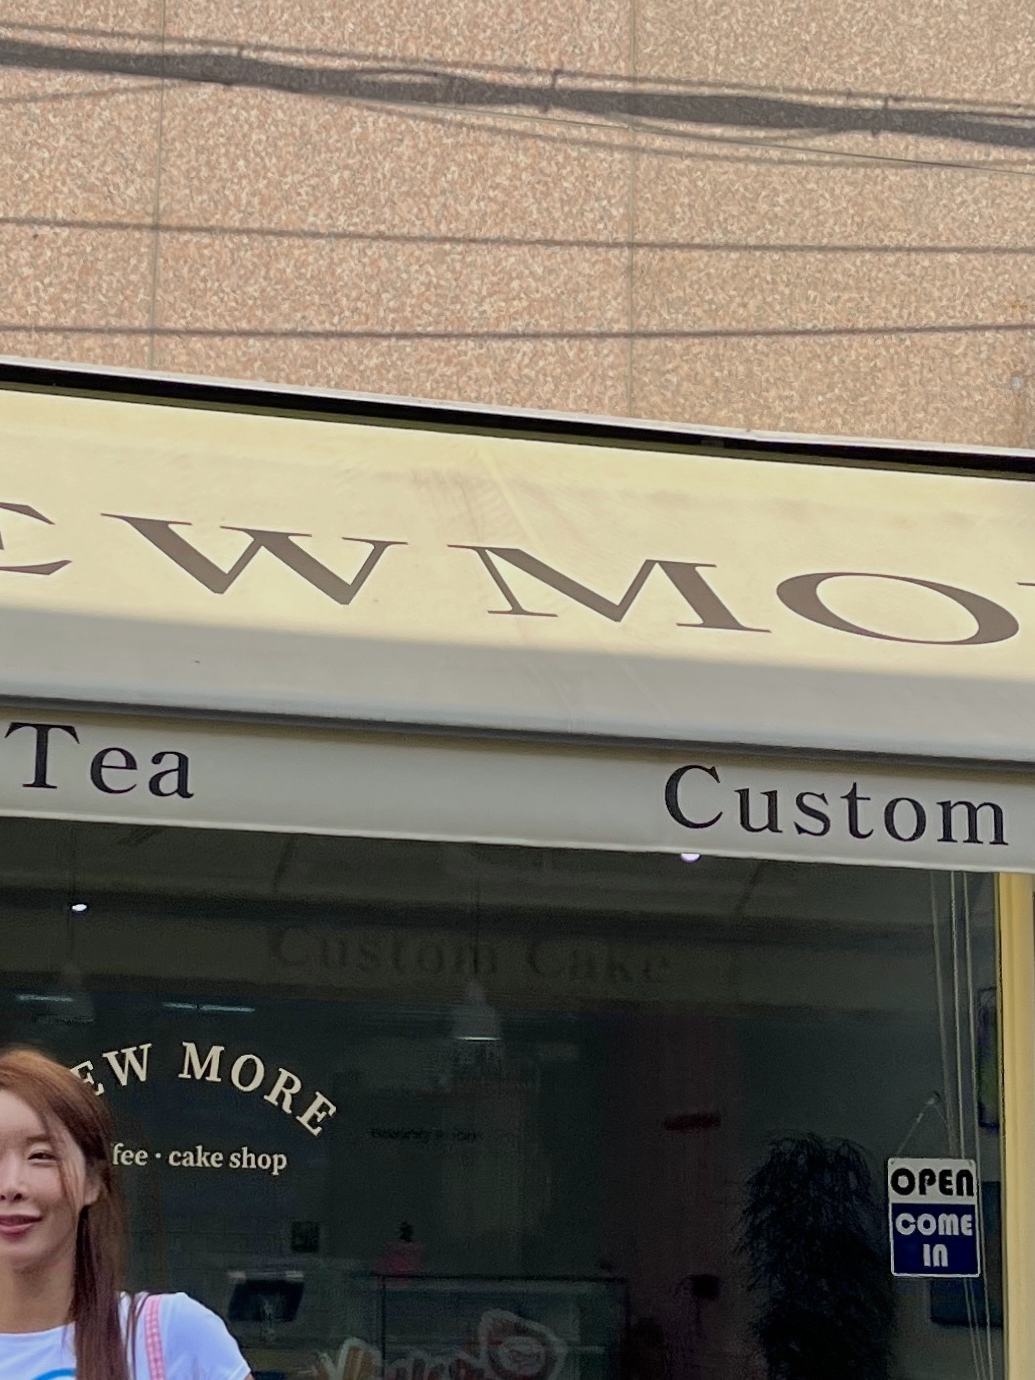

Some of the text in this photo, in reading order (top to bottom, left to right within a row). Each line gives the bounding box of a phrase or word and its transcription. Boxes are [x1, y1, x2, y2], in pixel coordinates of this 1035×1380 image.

[3, 721, 195, 800] Tea
[664, 764, 1009, 847] Custom
[69, 1041, 337, 1137] EW MORE
[168, 1144, 224, 1168] cake
[228, 1146, 288, 1176] shop
[890, 1167, 975, 1197] OPEN
[895, 1212, 974, 1237] COME
[922, 1243, 949, 1268] IN
